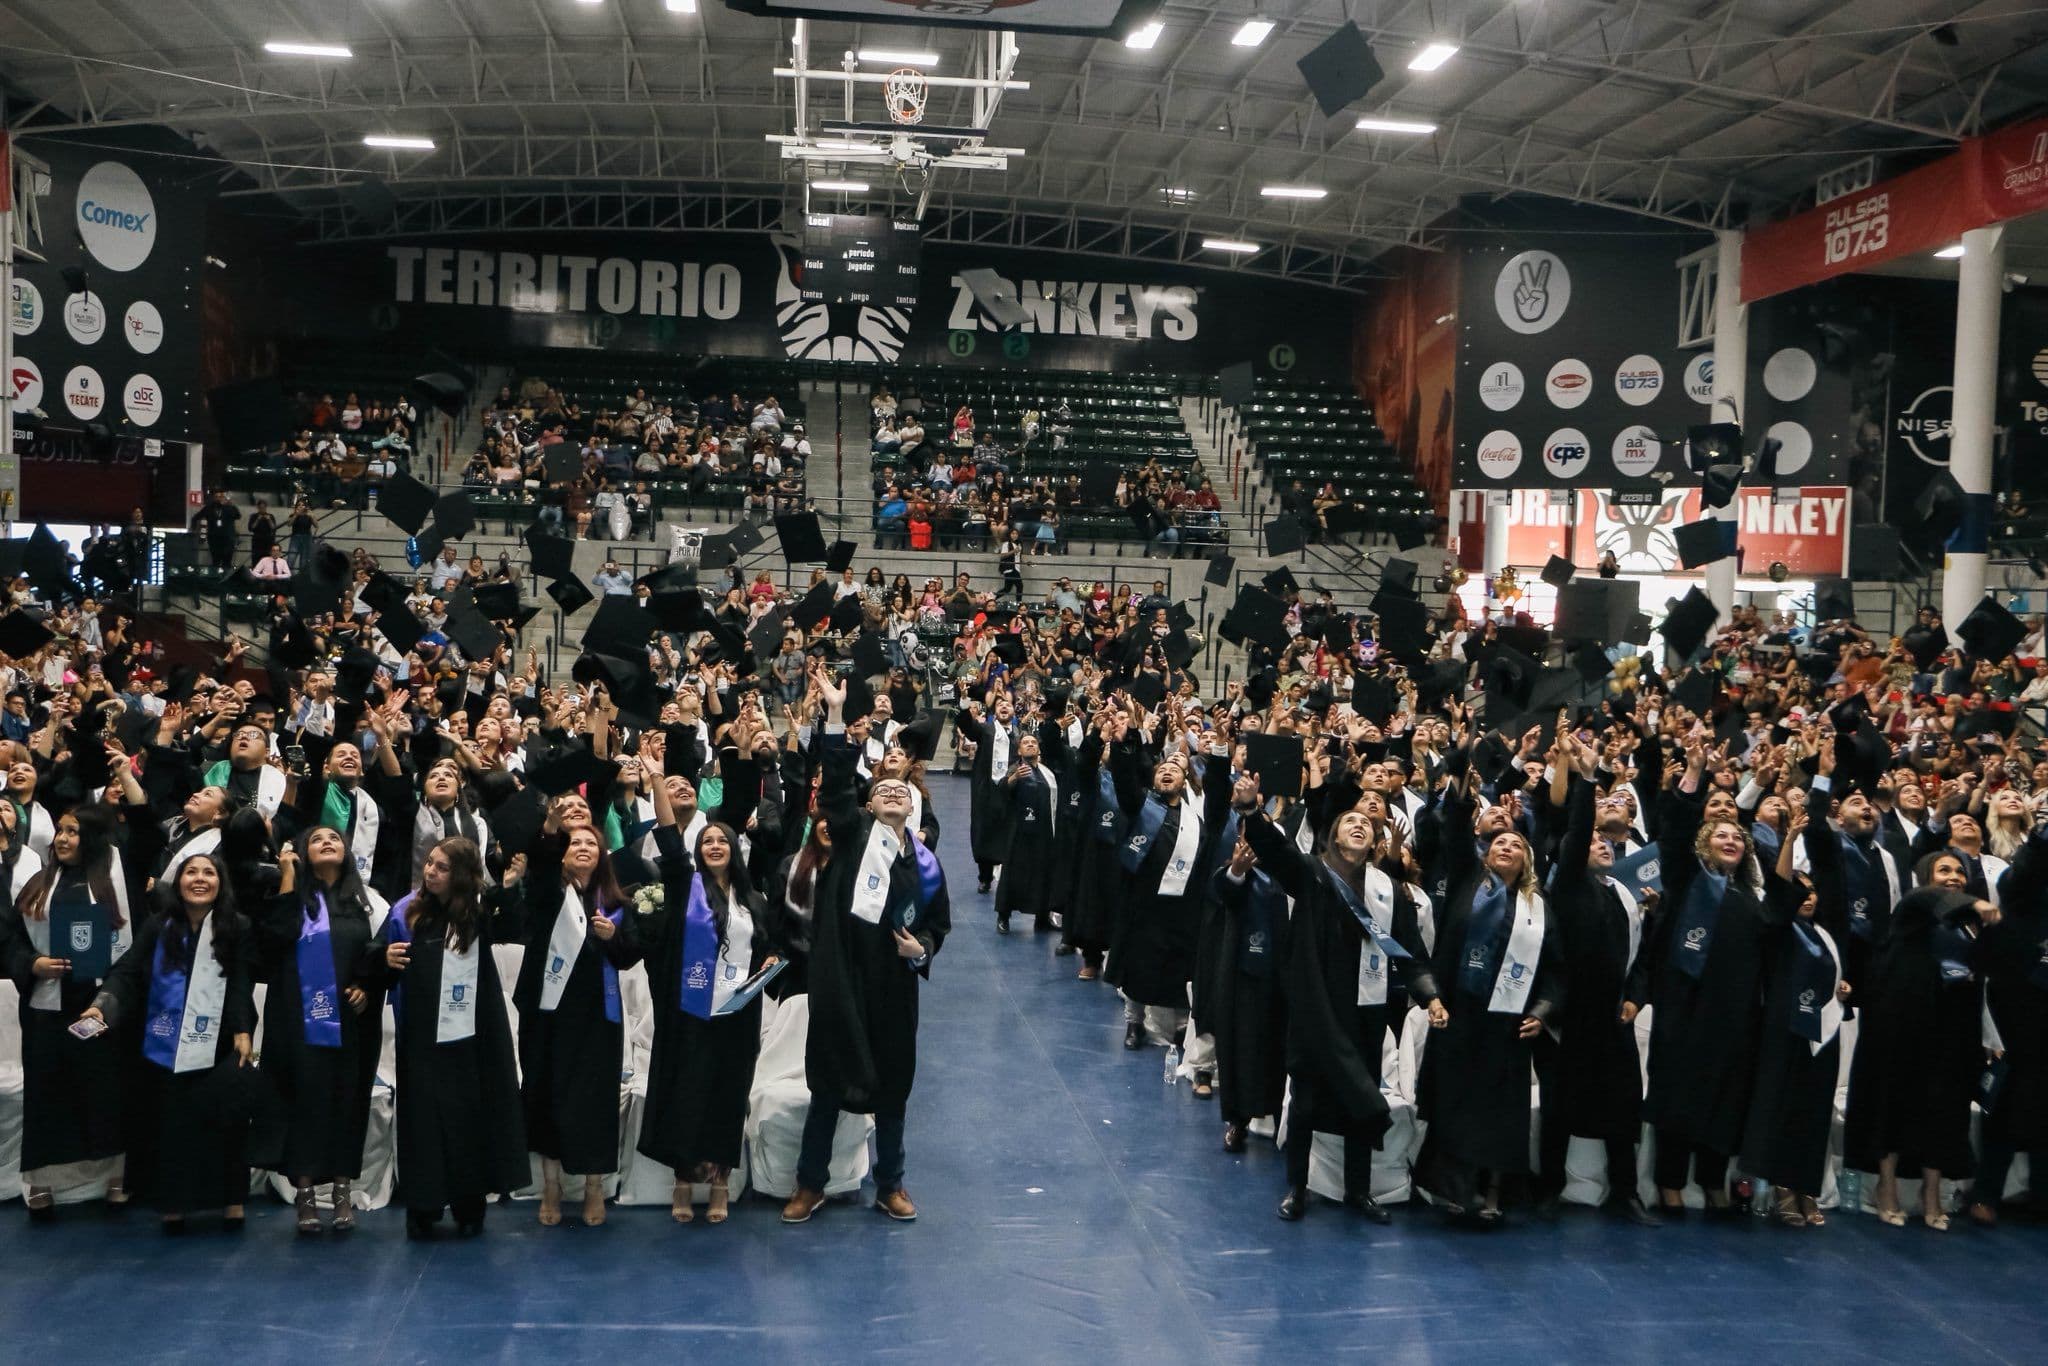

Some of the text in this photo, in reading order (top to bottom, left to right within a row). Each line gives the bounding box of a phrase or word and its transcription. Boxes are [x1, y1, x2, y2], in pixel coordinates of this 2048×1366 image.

[82, 200, 150, 233] Comex
[808, 216, 830, 227] Local
[1826, 193, 1889, 231] PULSAR
[387, 246, 742, 321] TERRITORIO
[69, 393, 99, 408] TECATE
[1553, 446, 1586, 467] cpe
[1625, 448, 1647, 458] mx
